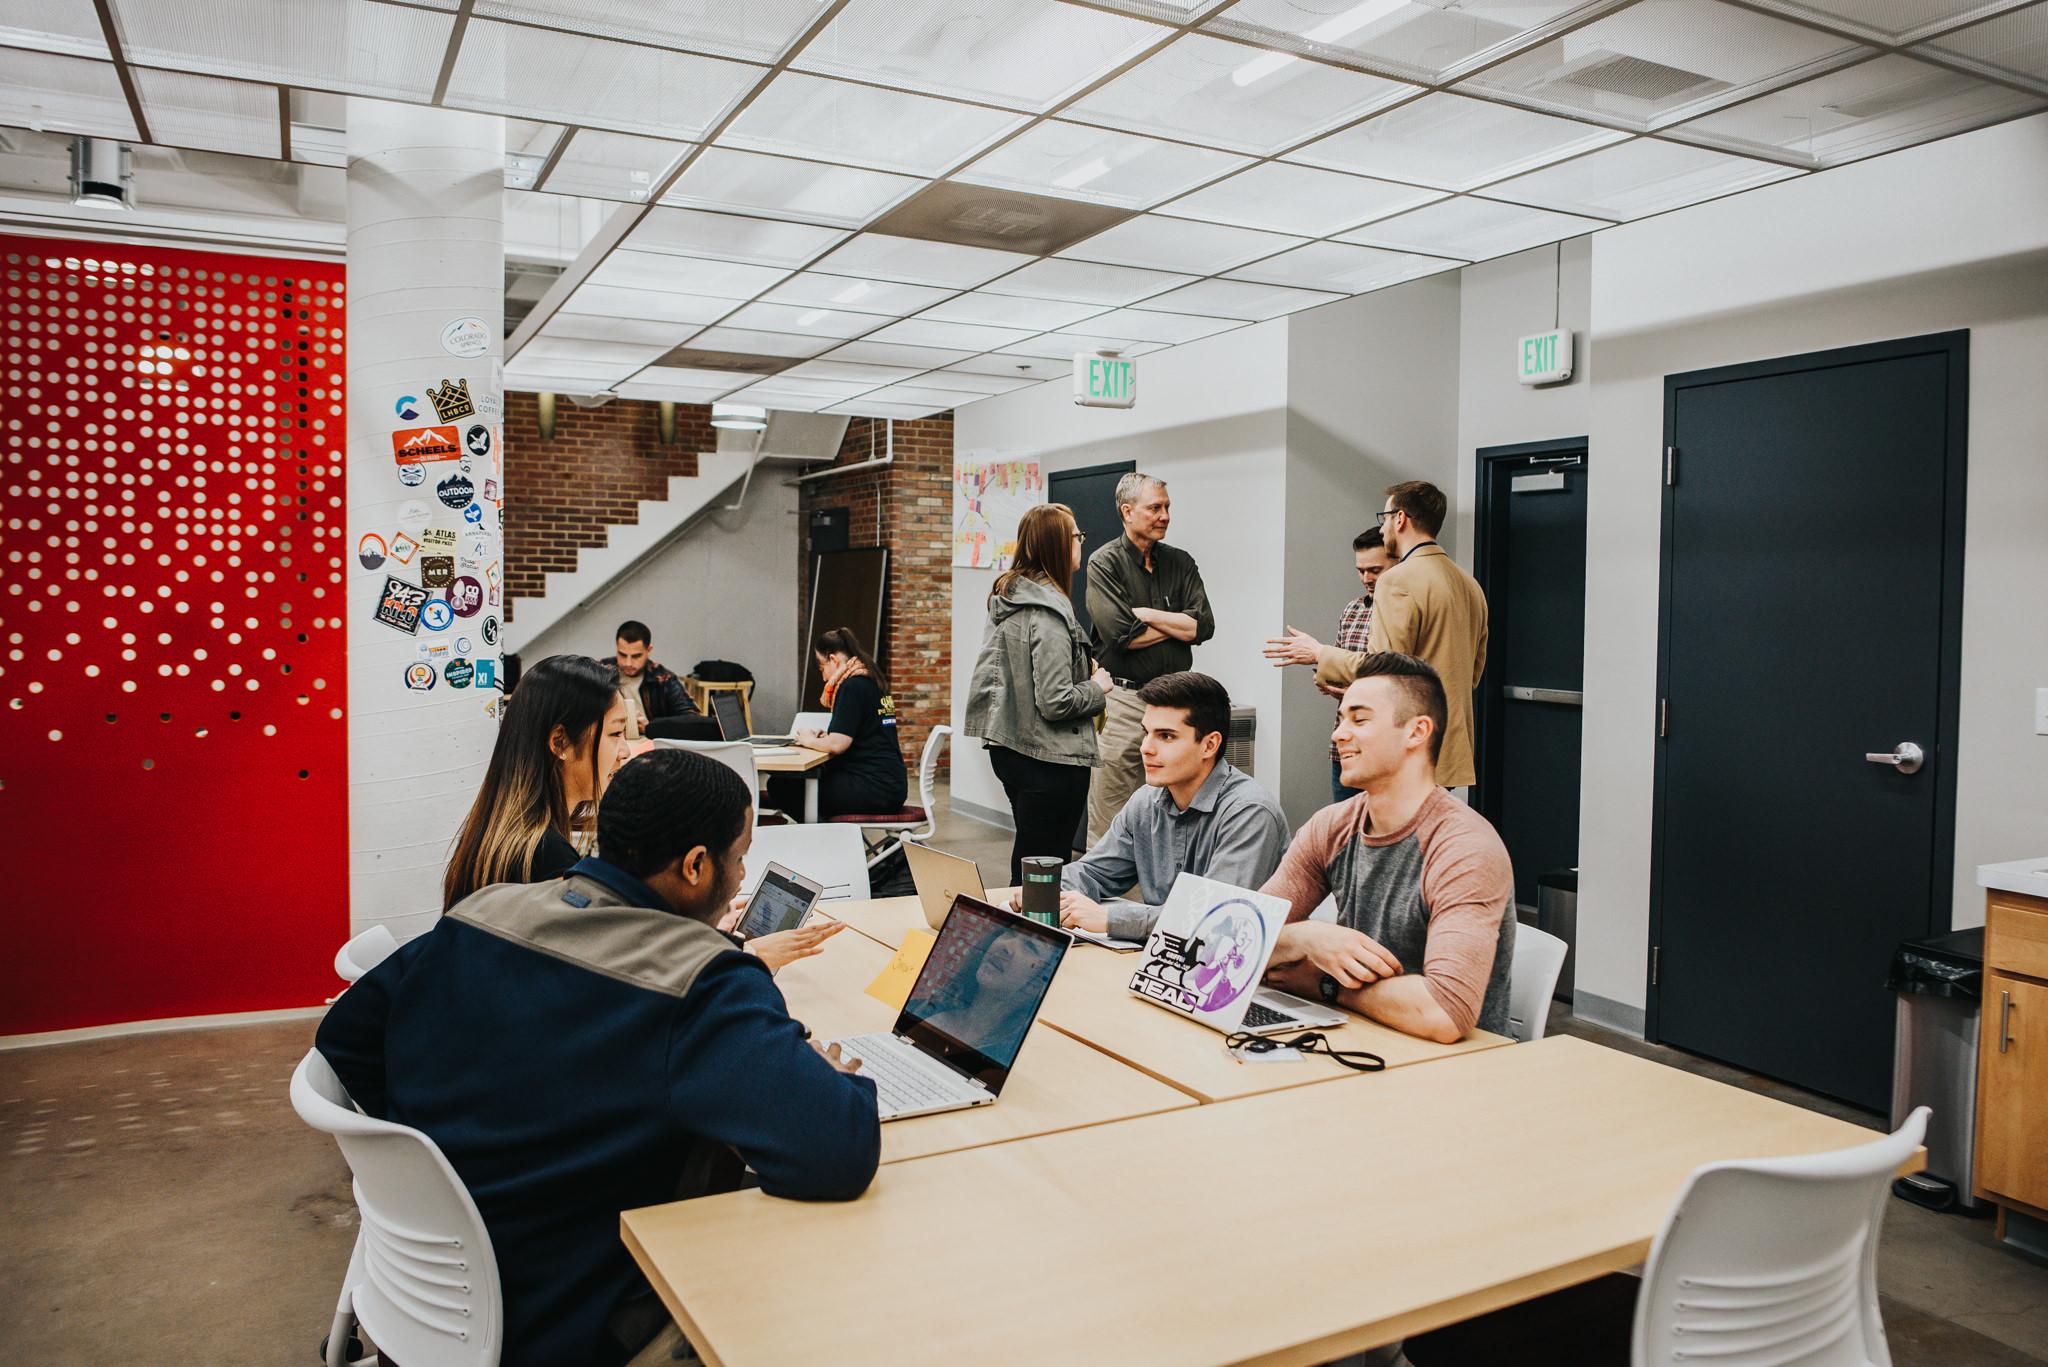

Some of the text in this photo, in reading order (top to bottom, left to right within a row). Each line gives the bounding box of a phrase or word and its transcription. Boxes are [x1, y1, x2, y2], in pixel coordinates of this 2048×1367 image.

[450, 332, 488, 345] COLORADO
[1524, 335, 1558, 374] EXIT
[1090, 360, 1131, 398] EXIT
[398, 444, 457, 458] SCHEELS
[439, 487, 474, 497] OUTDOOR
[436, 530, 456, 539] ATLAS
[381, 597, 418, 624] KILO
[477, 672, 488, 685] XI
